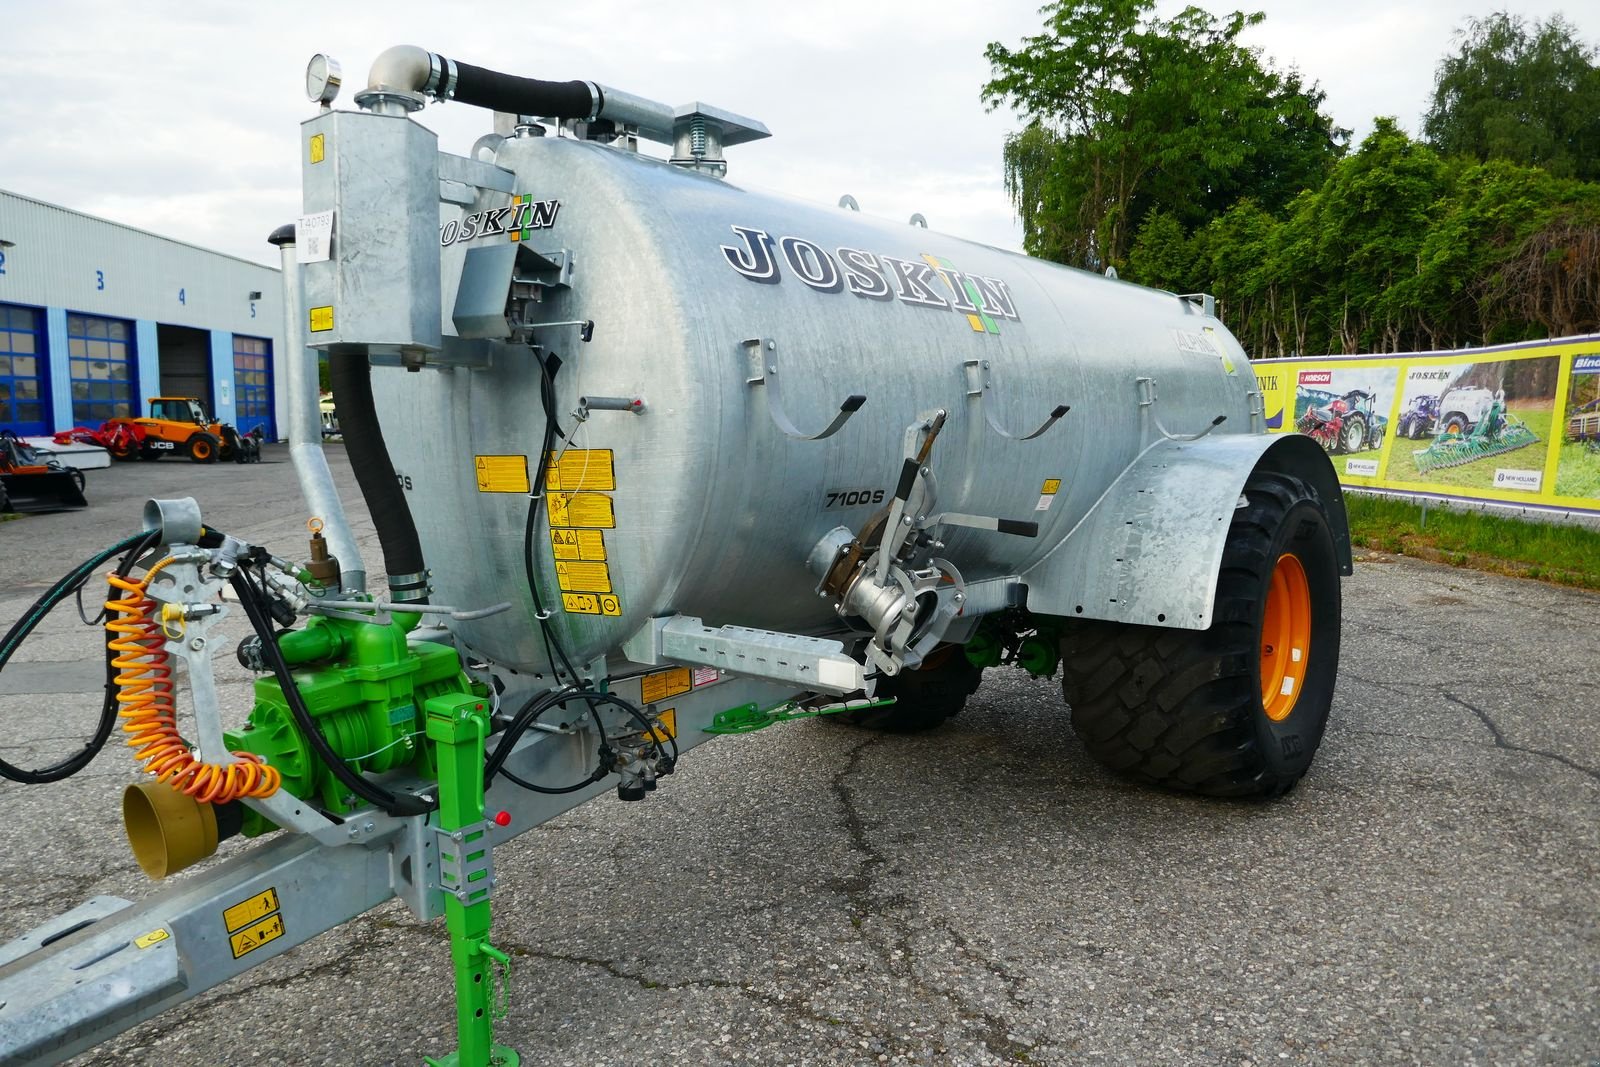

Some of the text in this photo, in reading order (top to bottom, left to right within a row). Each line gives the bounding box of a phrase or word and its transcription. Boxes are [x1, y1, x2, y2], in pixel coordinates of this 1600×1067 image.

[440, 198, 561, 247] OSKIN
[96, 270, 105, 291] 3
[720, 225, 1021, 323] JOSKIN
[178, 288, 186, 306] 4
[250, 302, 256, 318] 5
[1256, 375, 1278, 391] NIK
[1408, 370, 1451, 380] JOSKIN
[150, 441, 175, 450] JCB
[826, 489, 885, 508] 7100S
